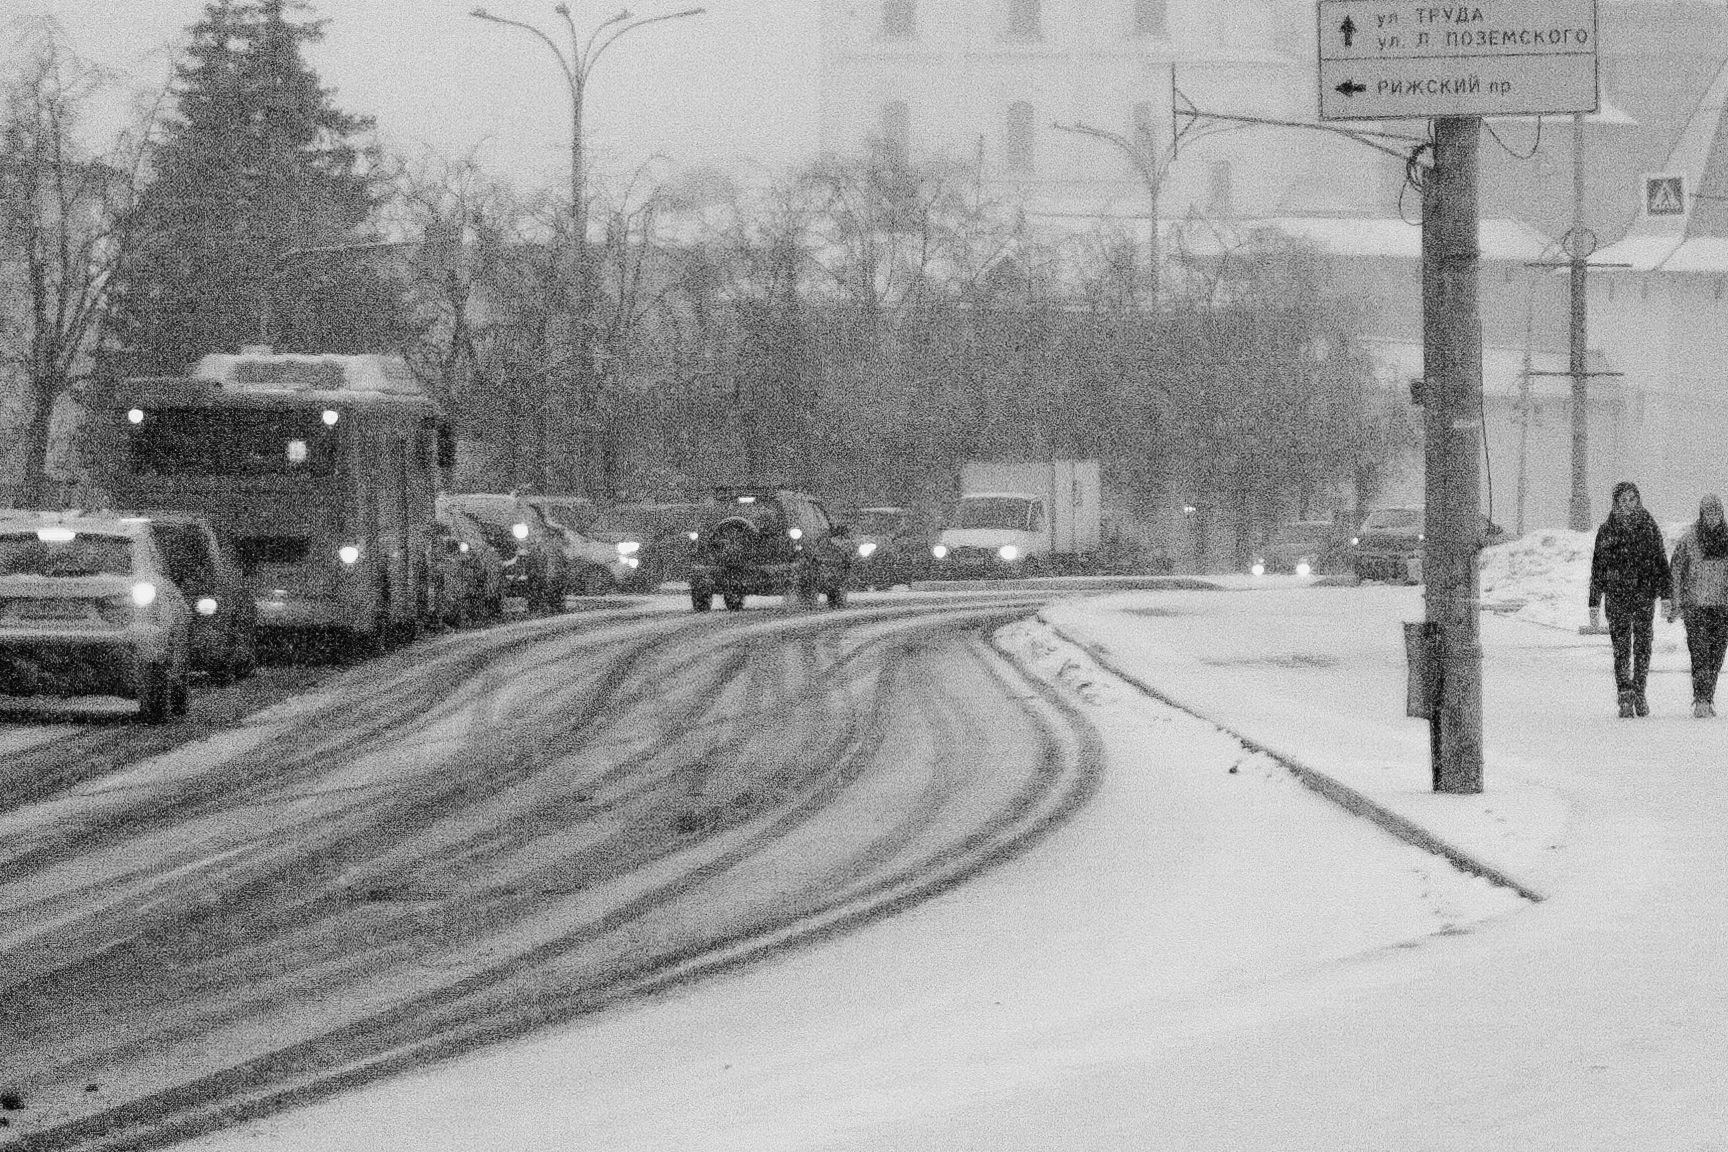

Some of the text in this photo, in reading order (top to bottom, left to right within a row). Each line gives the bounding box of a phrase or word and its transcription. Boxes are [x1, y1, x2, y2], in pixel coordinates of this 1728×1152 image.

[1415, 6, 1485, 25] ТРУДА
[1446, 28, 1589, 47] ПОЗЕМСКОГО
[1377, 73, 1480, 95] РИЖСКИЙ
